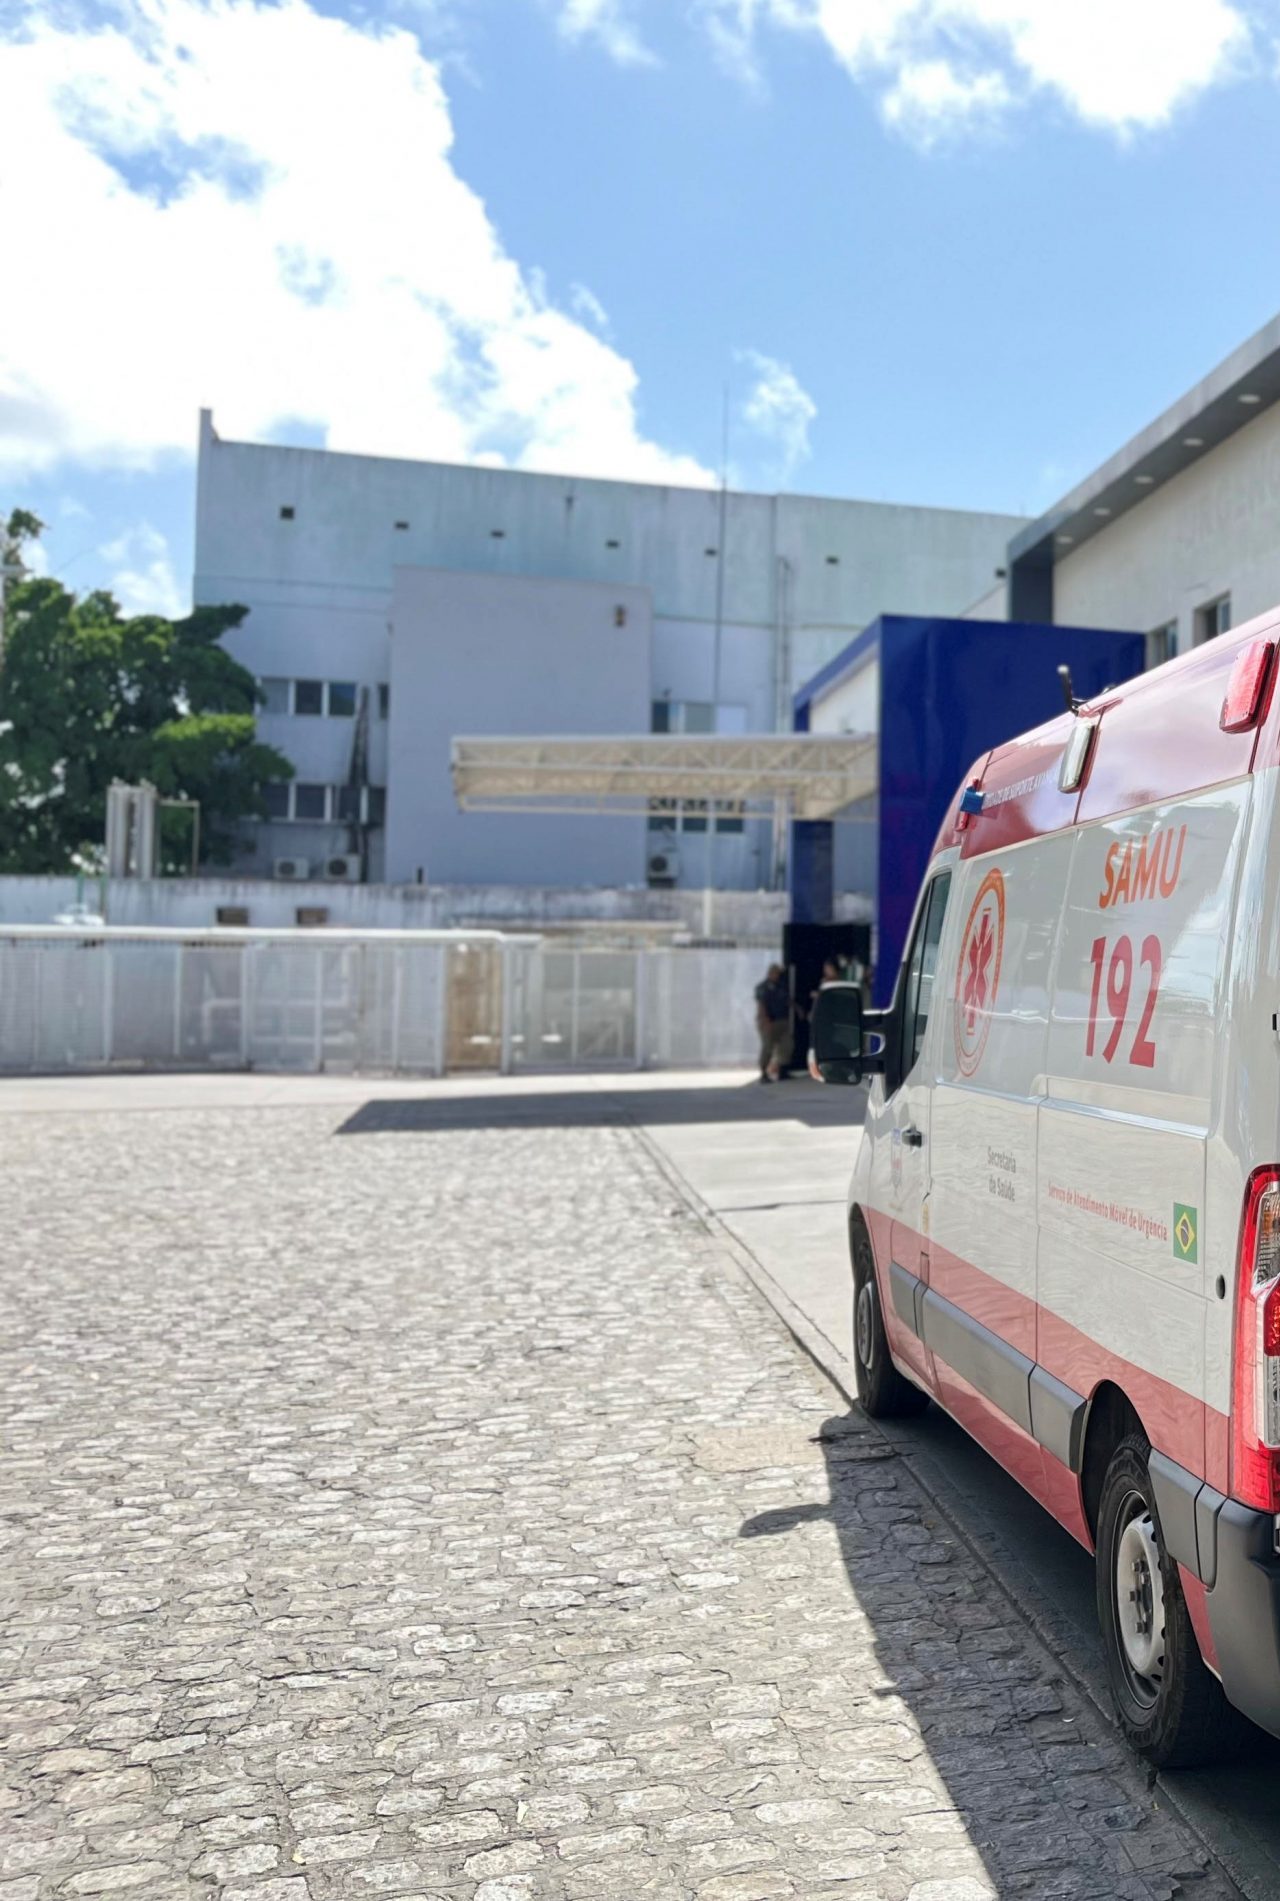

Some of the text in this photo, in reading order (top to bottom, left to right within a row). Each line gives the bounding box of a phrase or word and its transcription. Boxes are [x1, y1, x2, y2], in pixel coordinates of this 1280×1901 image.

[1099, 824, 1187, 909] SAMU
[1085, 934, 1162, 1068] 192
[987, 1145, 1016, 1174] Secretaria
[1129, 1208, 1137, 1229] de
[1138, 1212, 1168, 1242] Urgência
